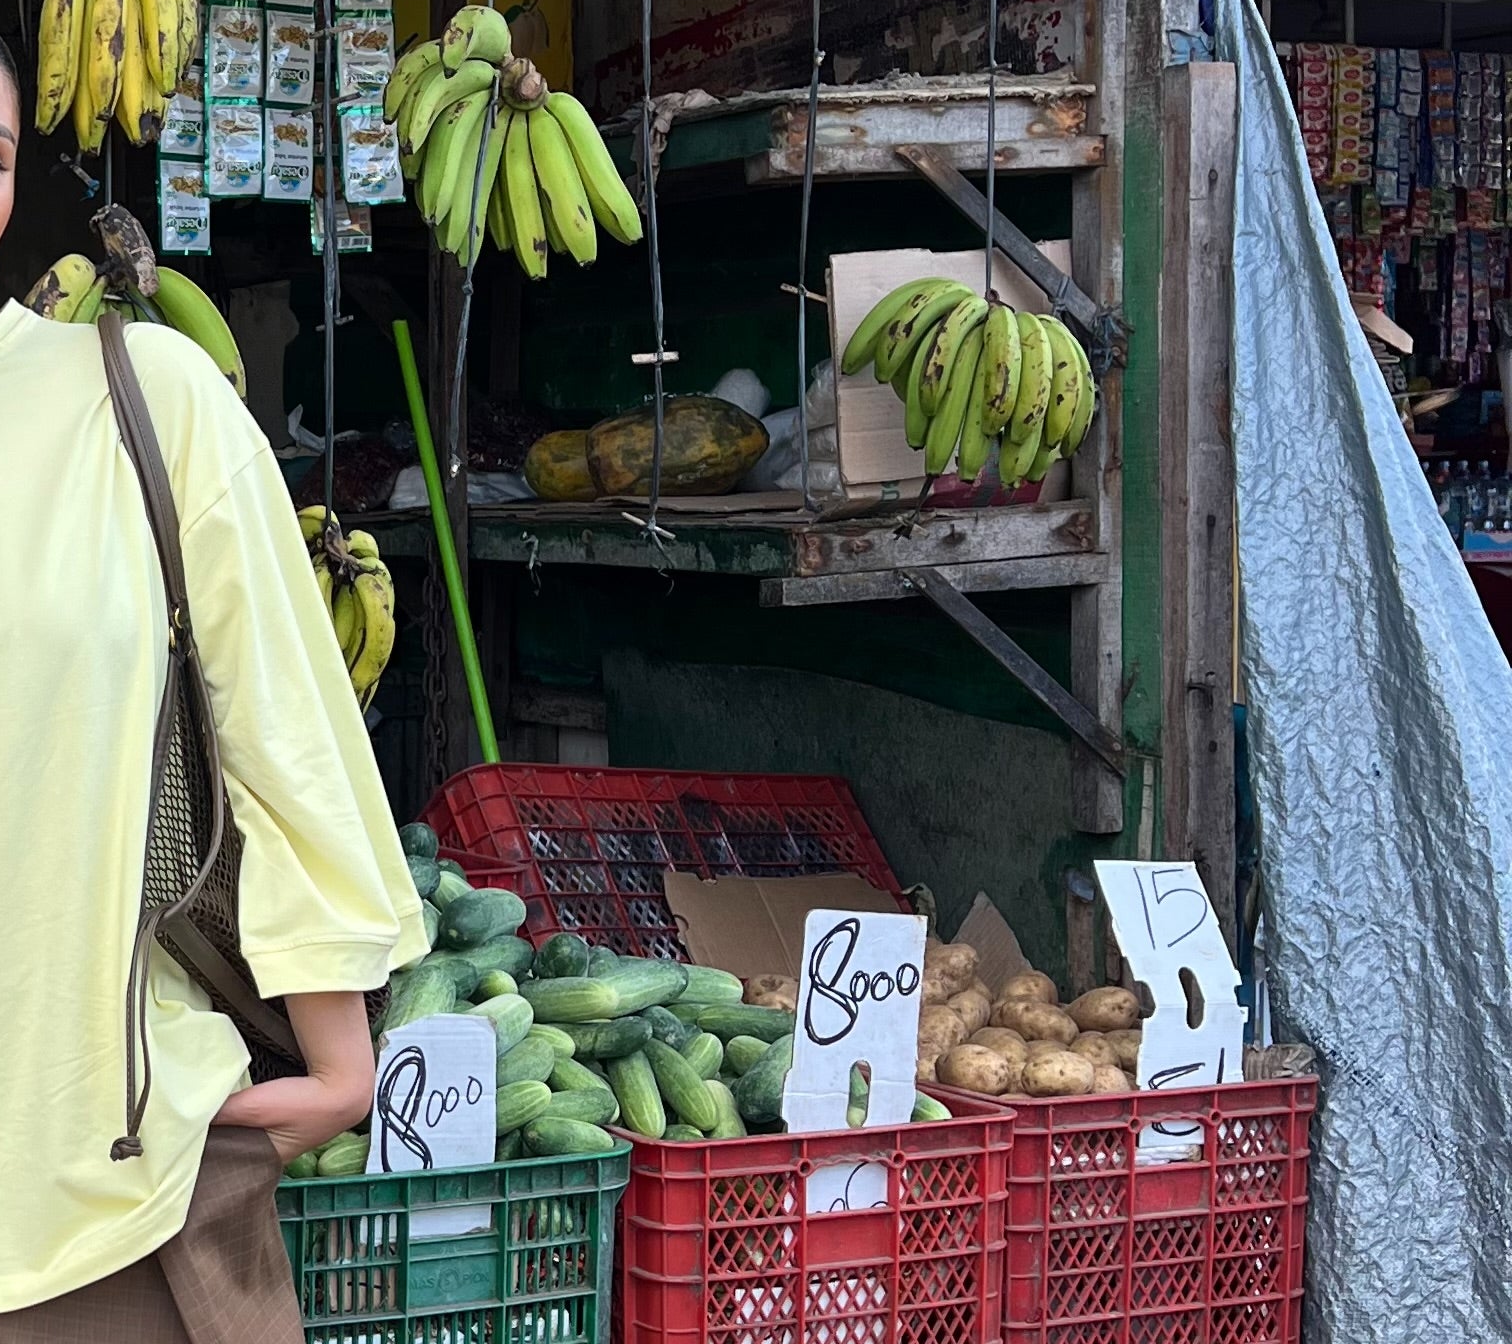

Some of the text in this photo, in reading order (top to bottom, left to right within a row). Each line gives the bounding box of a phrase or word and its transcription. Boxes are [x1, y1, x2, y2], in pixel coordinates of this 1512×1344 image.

[1133, 867, 1208, 950] 15
[803, 917, 920, 1046] 8000
[376, 1044, 483, 1172] 8000
